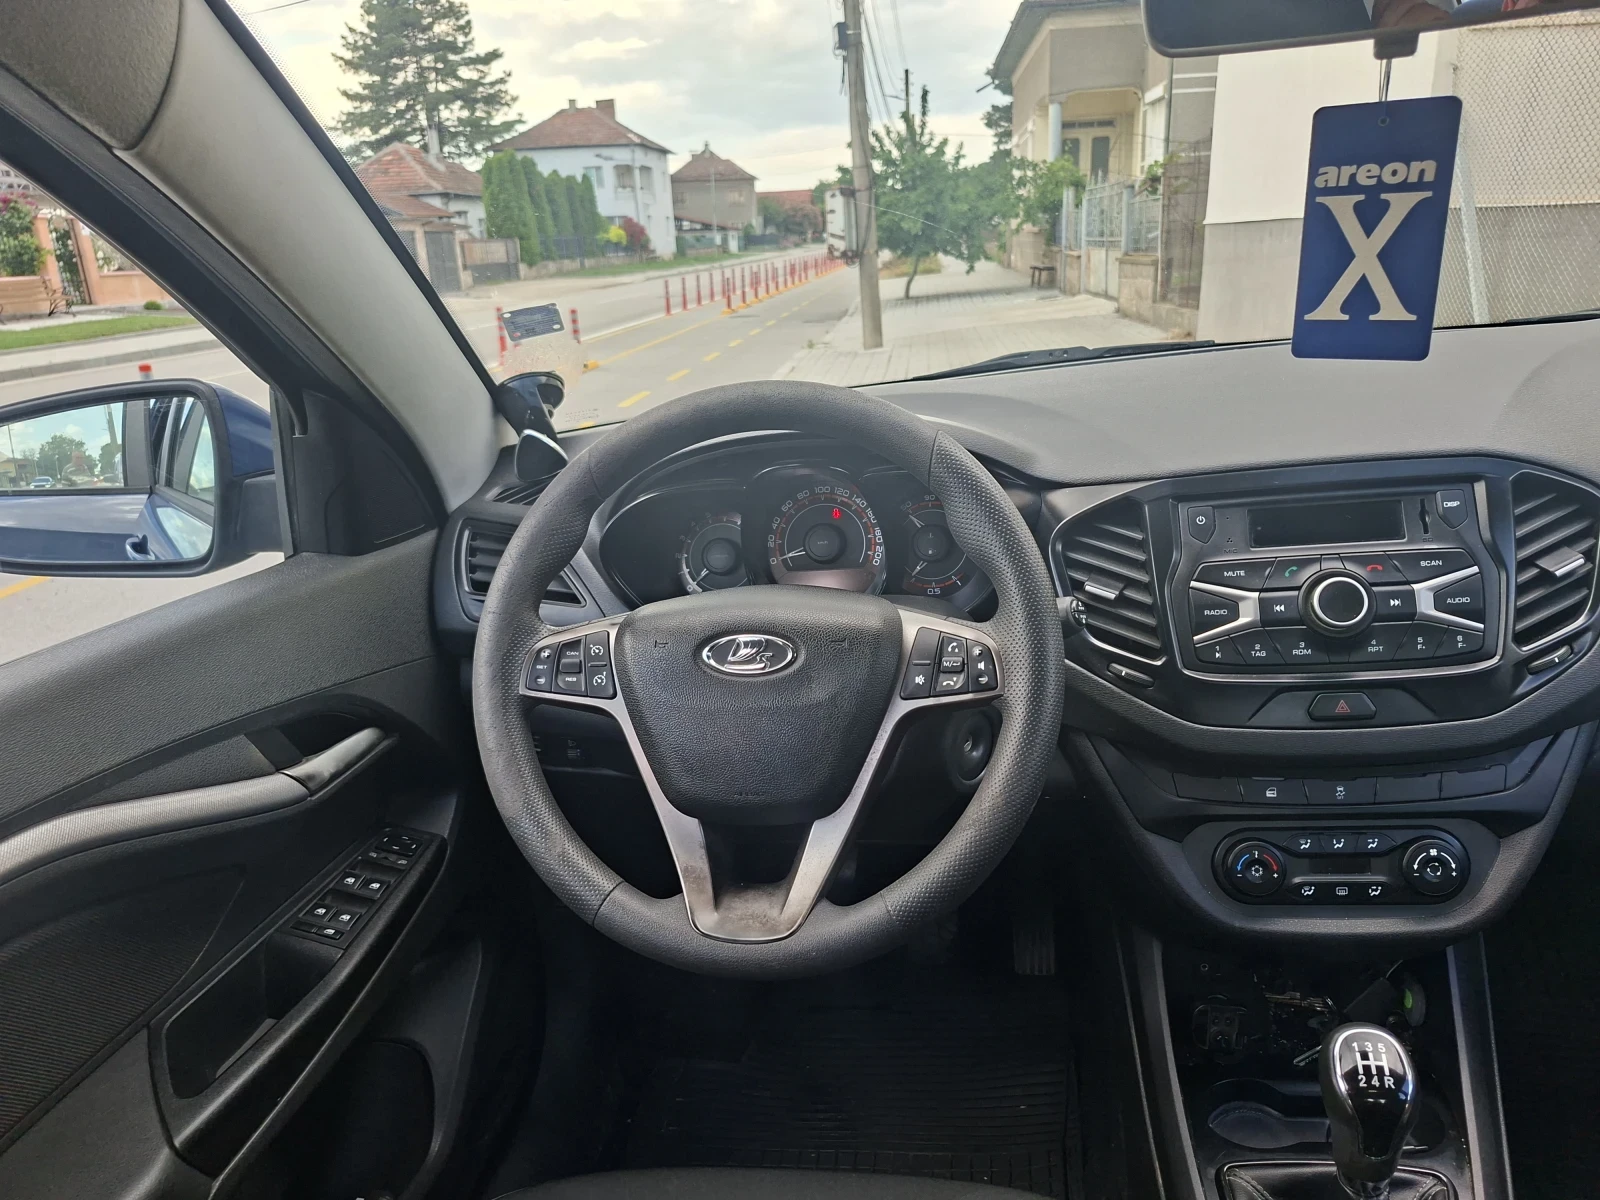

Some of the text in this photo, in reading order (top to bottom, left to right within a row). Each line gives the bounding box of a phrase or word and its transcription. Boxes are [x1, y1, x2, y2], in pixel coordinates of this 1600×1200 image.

[1314, 160, 1437, 188] areon
[1304, 191, 1433, 320] X
[796, 490, 810, 500] 80
[814, 486, 831, 494] 100
[834, 487, 850, 497] 120
[781, 500, 793, 512] 60
[852, 494, 867, 508] 140
[771, 516, 780, 529] 40
[865, 508, 877, 524] 160
[767, 535, 775, 548] 20
[874, 527, 883, 543] 180
[769, 557, 777, 565] 0
[873, 545, 883, 566] 200
[1352, 1041, 1386, 1053] 1 3 5
[1358, 1075, 1395, 1089] 2 4 R
